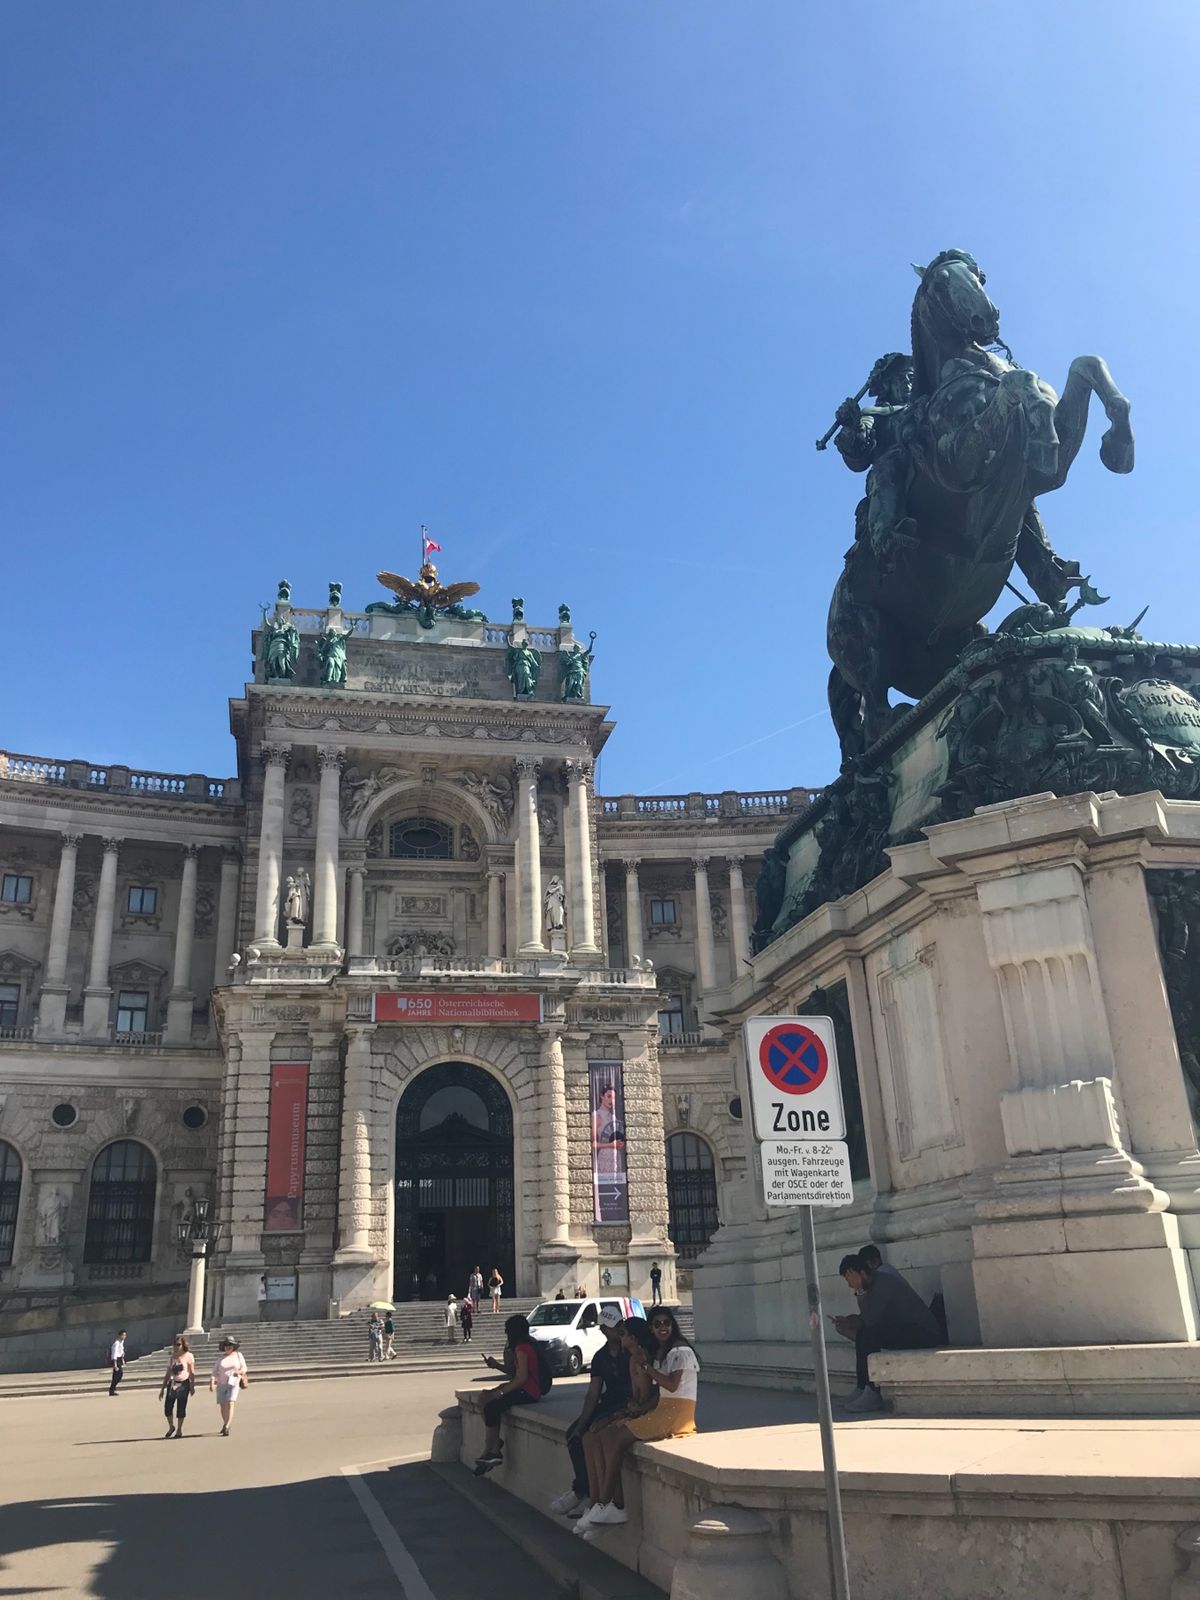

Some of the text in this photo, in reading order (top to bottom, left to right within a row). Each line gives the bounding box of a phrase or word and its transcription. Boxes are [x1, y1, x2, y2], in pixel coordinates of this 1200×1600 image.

[408, 998, 432, 1009] 650
[407, 1009, 432, 1017] JAHRE
[438, 1008, 520, 1017] Nationalbibliothek
[771, 1102, 830, 1132] Zone
[287, 1102, 301, 1199] Papyrusmuseum
[776, 1145, 804, 1155] Mo.-Fr.
[767, 1157, 844, 1167] ausgen. Fahrzeuge
[774, 1168, 839, 1178] mit Wagenkarte
[772, 1179, 844, 1189] der OSCE oder der
[767, 1190, 851, 1200] Parlamentsdirektion
